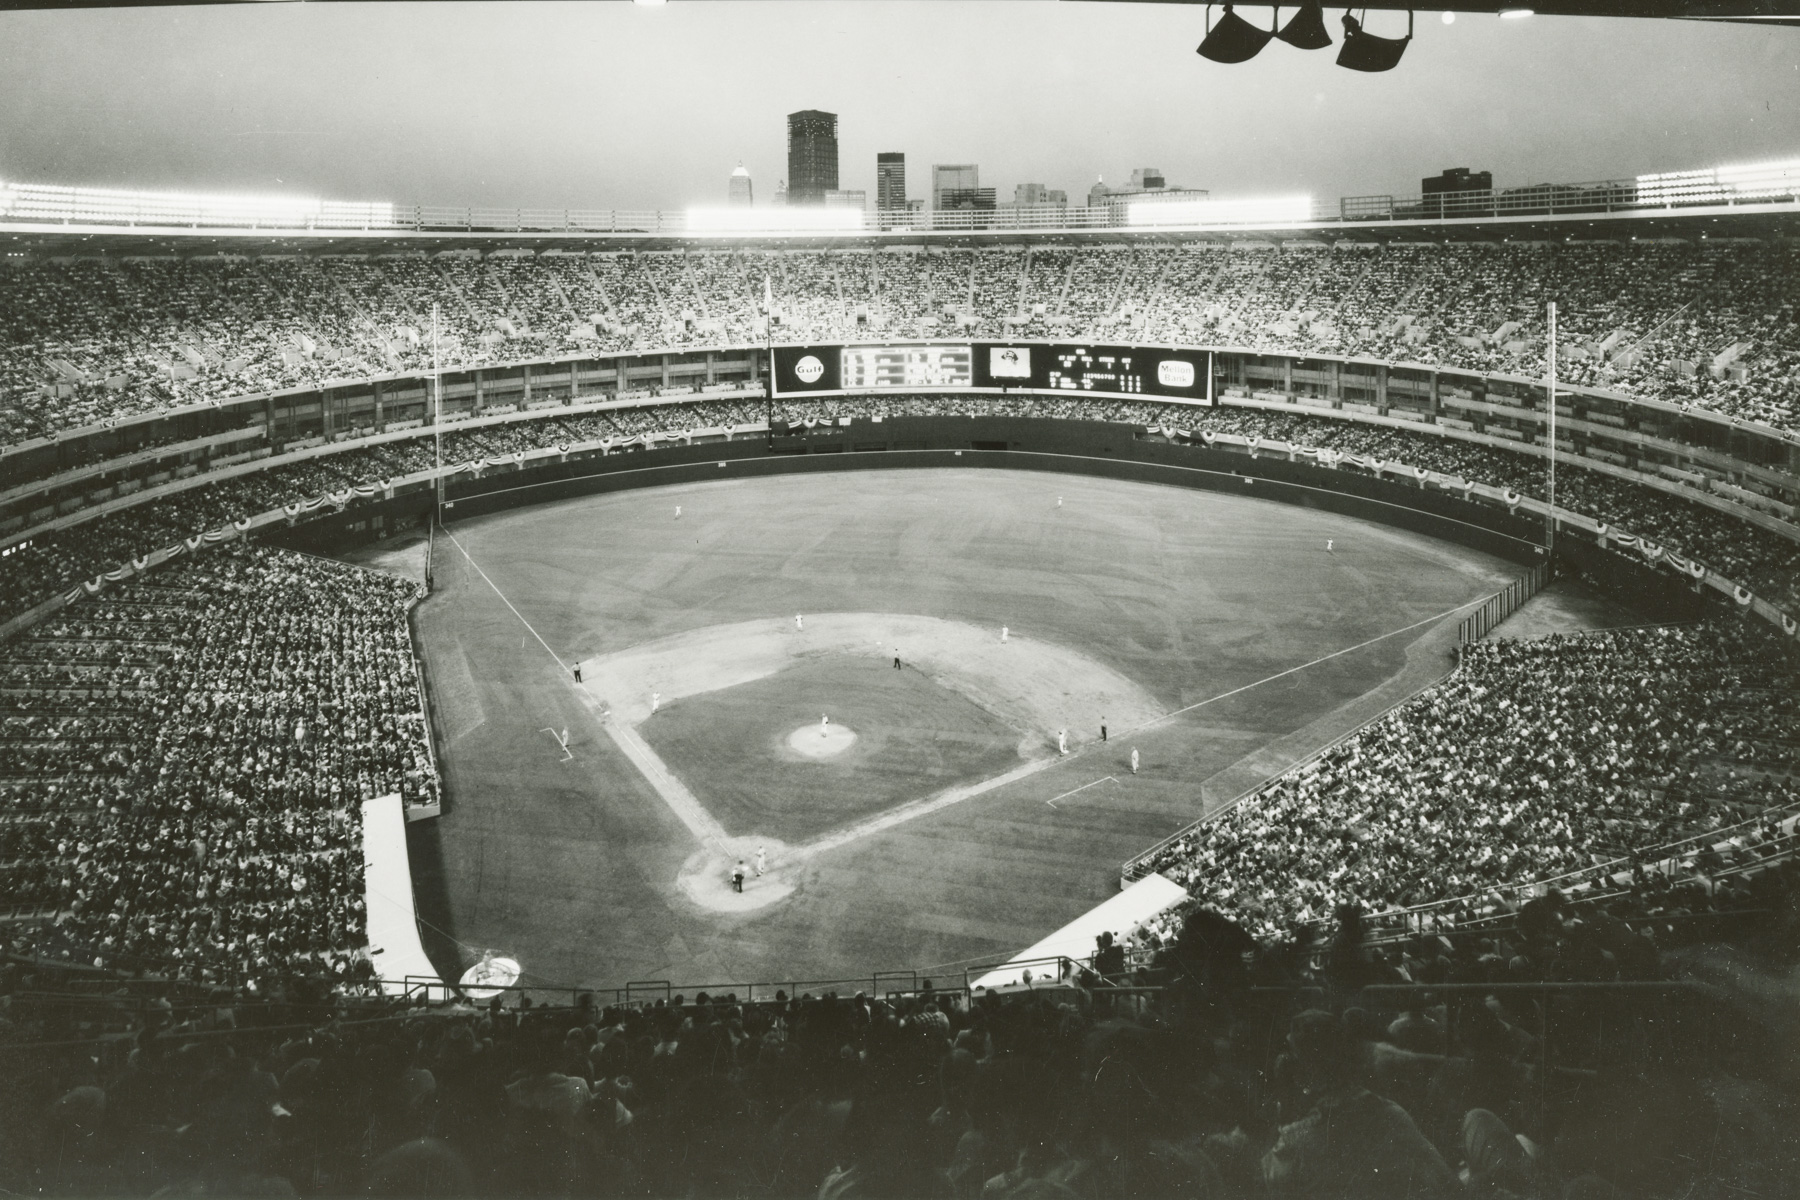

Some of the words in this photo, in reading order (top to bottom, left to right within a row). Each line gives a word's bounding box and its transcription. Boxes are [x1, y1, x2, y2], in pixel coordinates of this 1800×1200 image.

[797, 365, 822, 374] Gulf
[1161, 365, 1191, 374] Mellon
[1164, 374, 1187, 382] Bank
[1534, 546, 1544, 555] 340
